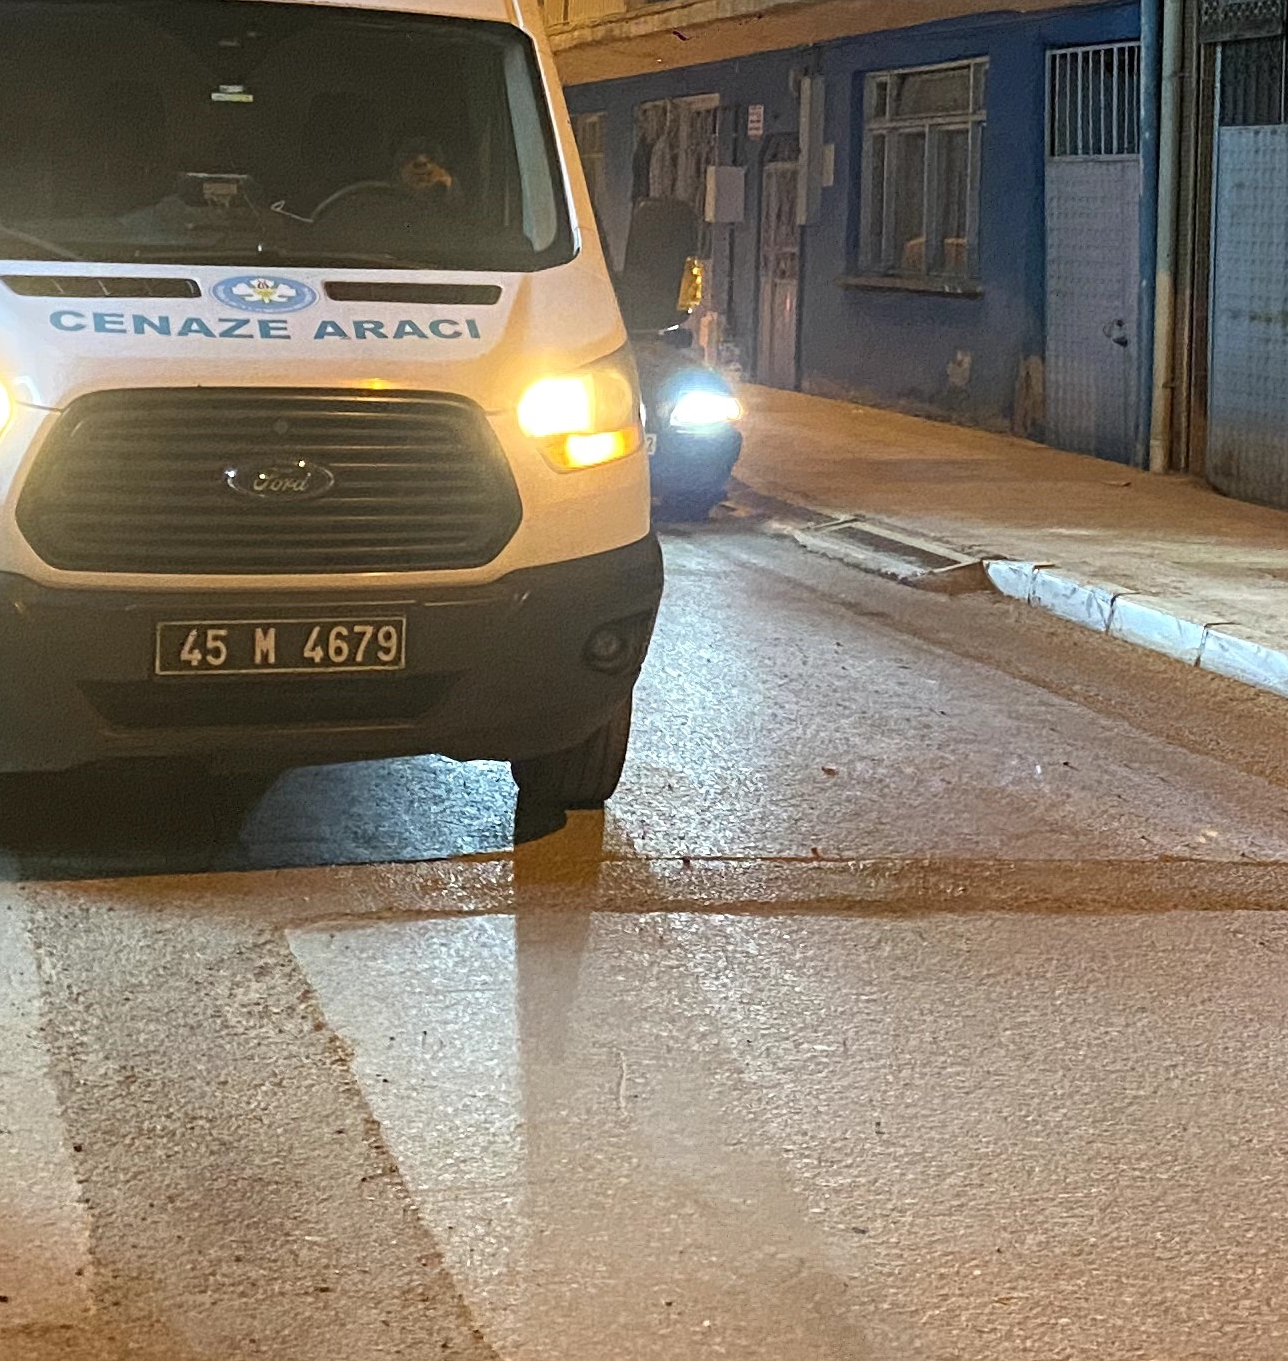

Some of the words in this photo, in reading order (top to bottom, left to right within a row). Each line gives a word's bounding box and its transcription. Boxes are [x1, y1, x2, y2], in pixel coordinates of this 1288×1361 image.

[48, 309, 292, 340] CENAZE
[312, 318, 482, 340] ARACI
[180, 629, 228, 666] 45
[254, 627, 276, 665] M
[303, 625, 398, 663] 4679
